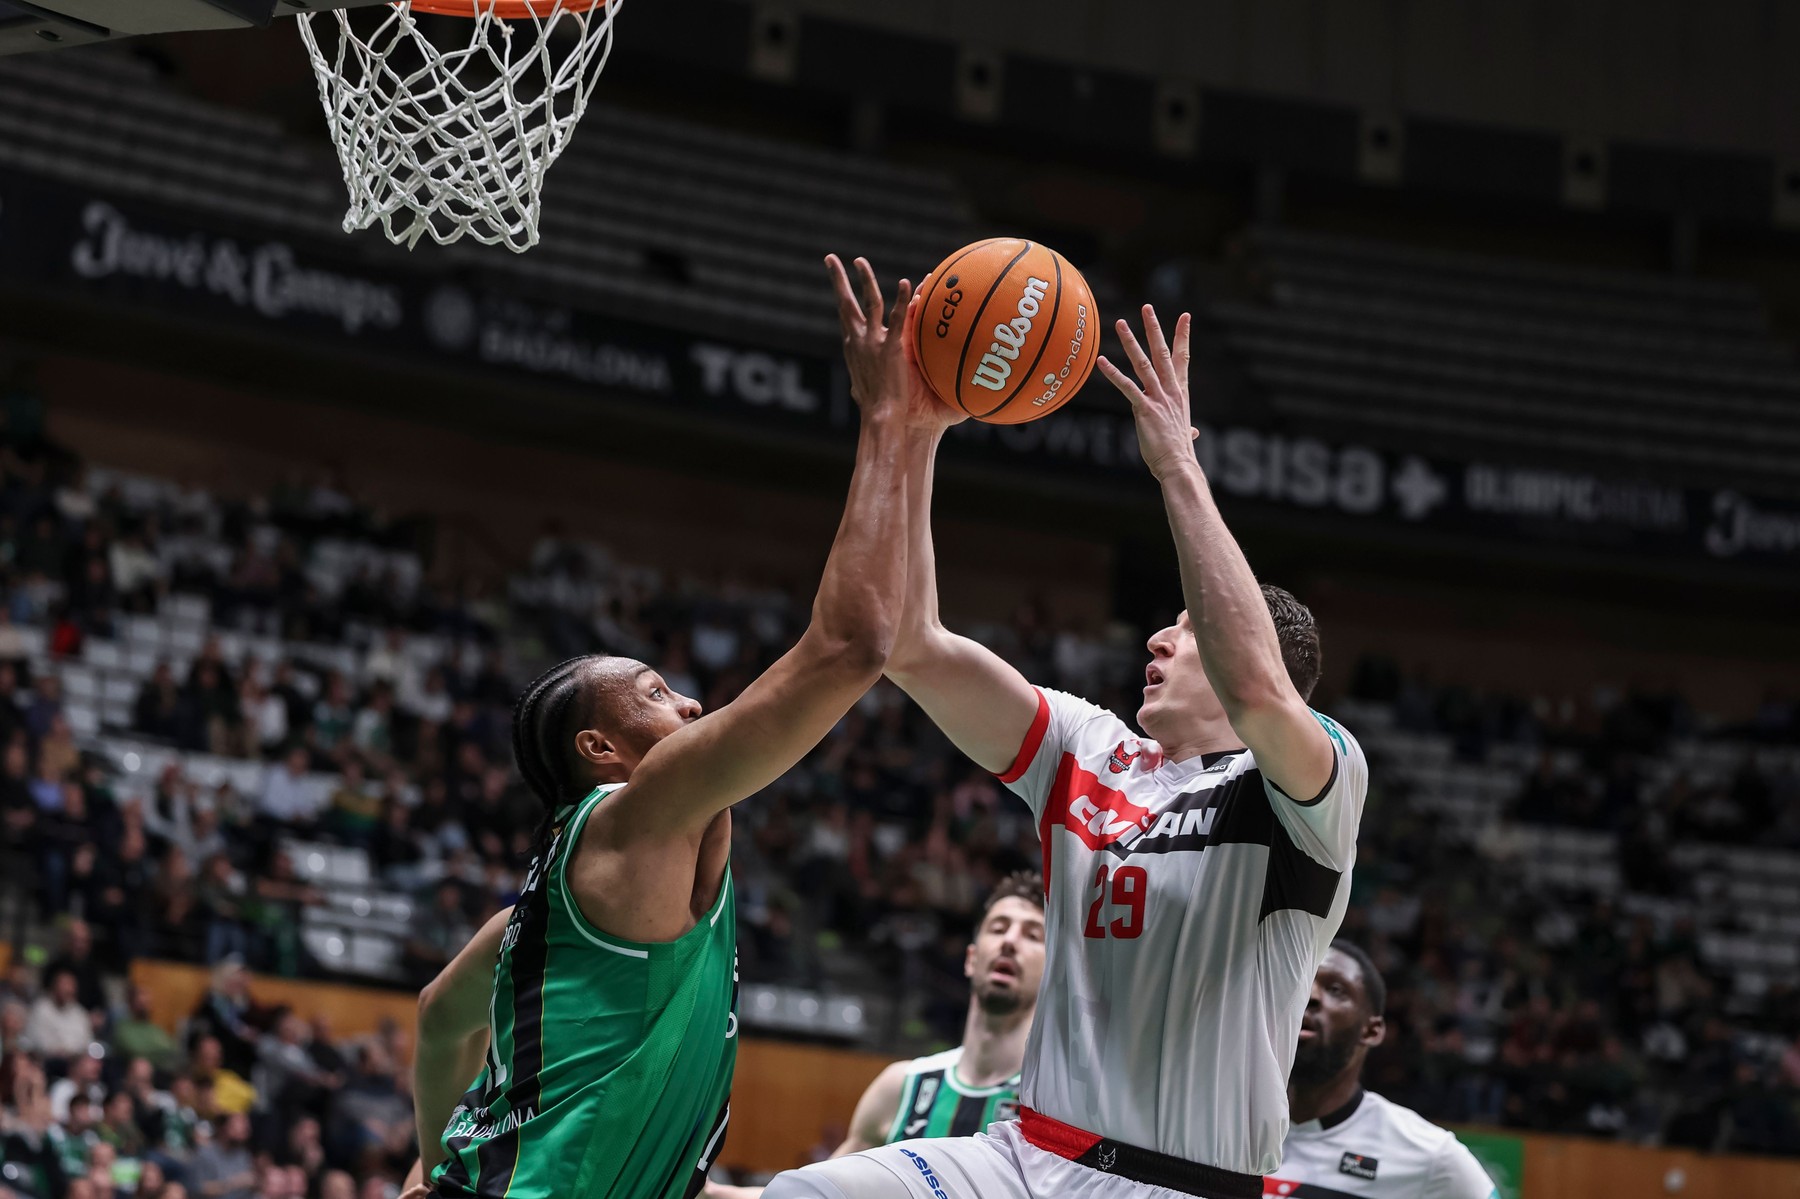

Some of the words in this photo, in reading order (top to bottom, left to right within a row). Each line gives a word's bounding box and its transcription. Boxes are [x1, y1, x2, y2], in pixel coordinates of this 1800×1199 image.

[936, 288, 964, 339] acb
[971, 276, 1050, 392] Wilson
[688, 341, 819, 414] TCL
[1032, 379, 1064, 408] liga
[1060, 304, 1087, 379] endesa
[1084, 864, 1147, 939] 29
